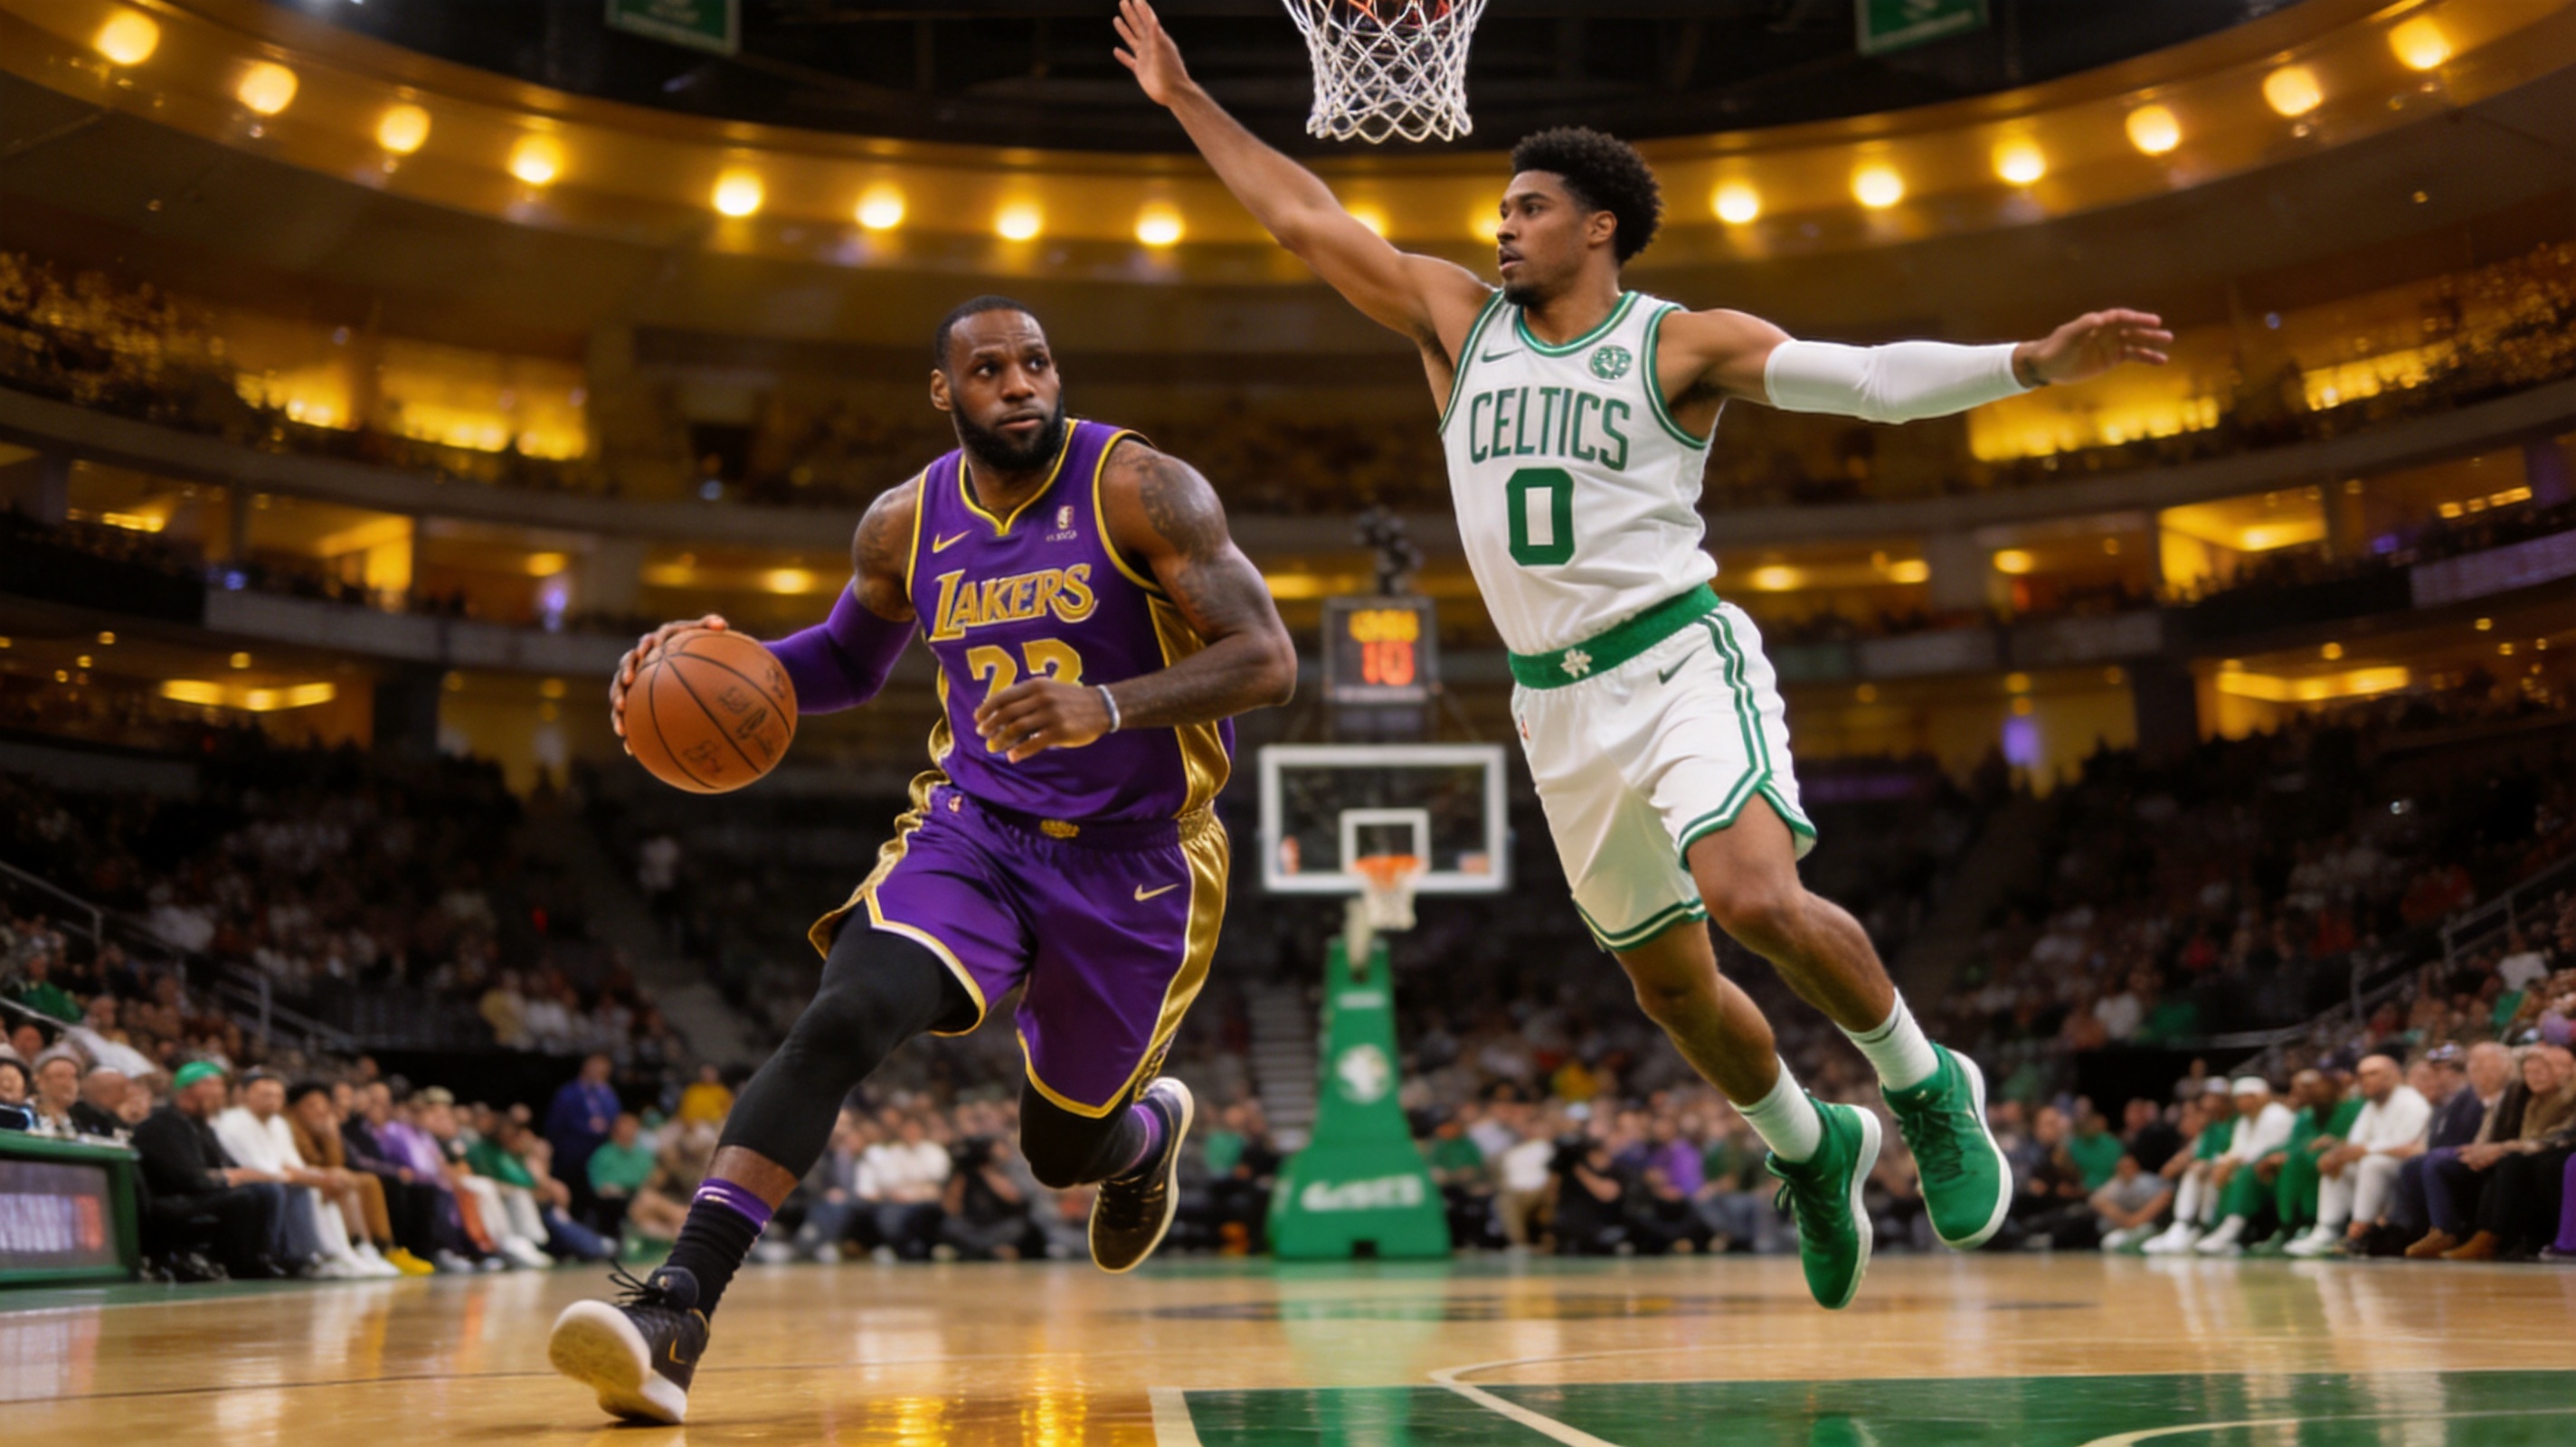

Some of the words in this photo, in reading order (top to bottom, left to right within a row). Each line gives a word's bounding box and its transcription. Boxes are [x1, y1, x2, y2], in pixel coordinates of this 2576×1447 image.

[1470, 386, 1631, 471] CELTICS
[1506, 468, 1576, 566] 0
[928, 563, 1099, 643] LAKERS
